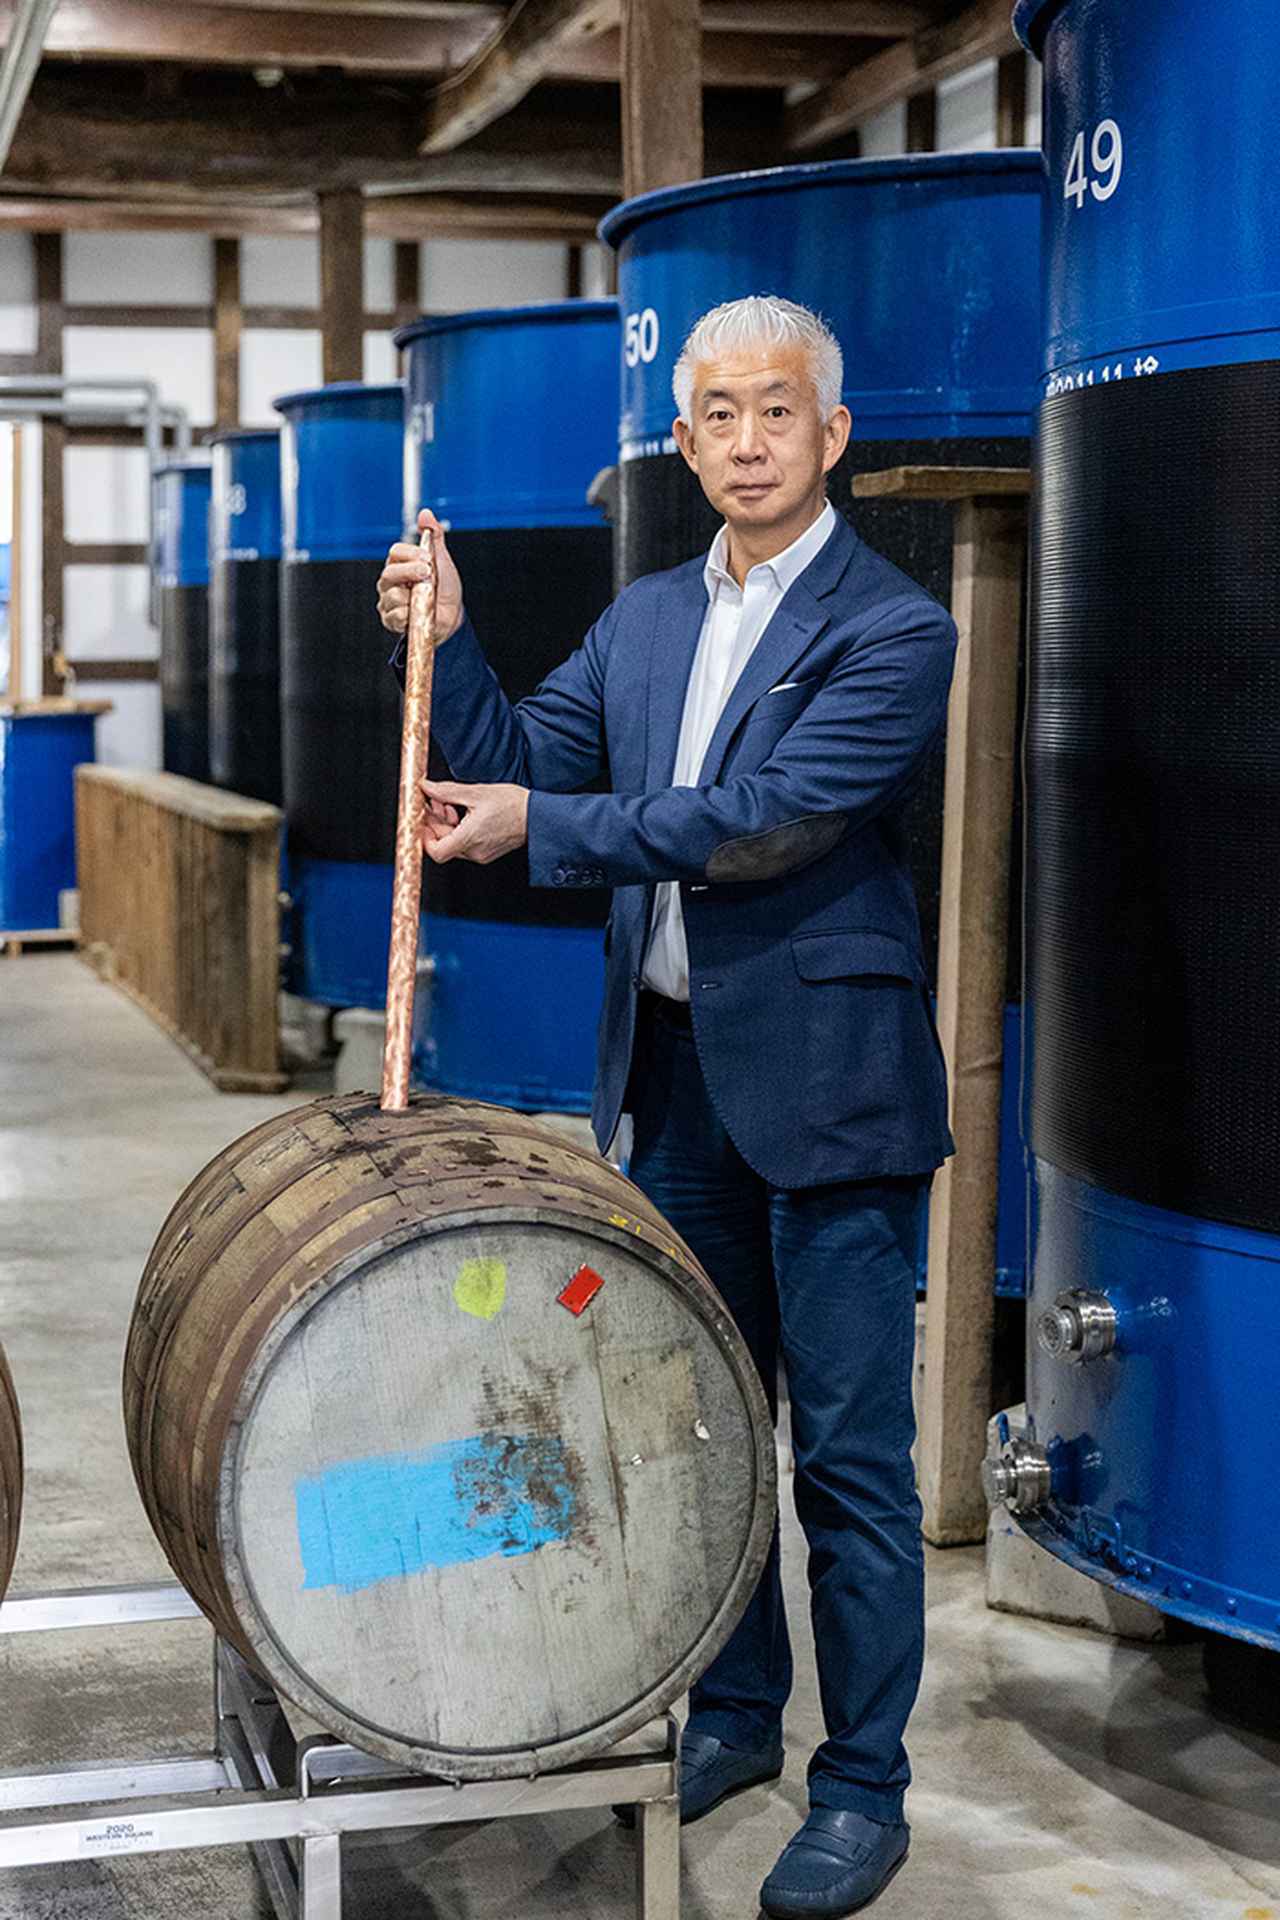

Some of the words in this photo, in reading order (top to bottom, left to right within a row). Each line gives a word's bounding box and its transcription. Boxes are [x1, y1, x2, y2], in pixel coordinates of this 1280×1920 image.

[1064, 118, 1123, 208] 49
[625, 307, 660, 368] 50
[105, 1823, 134, 1834] 2020
